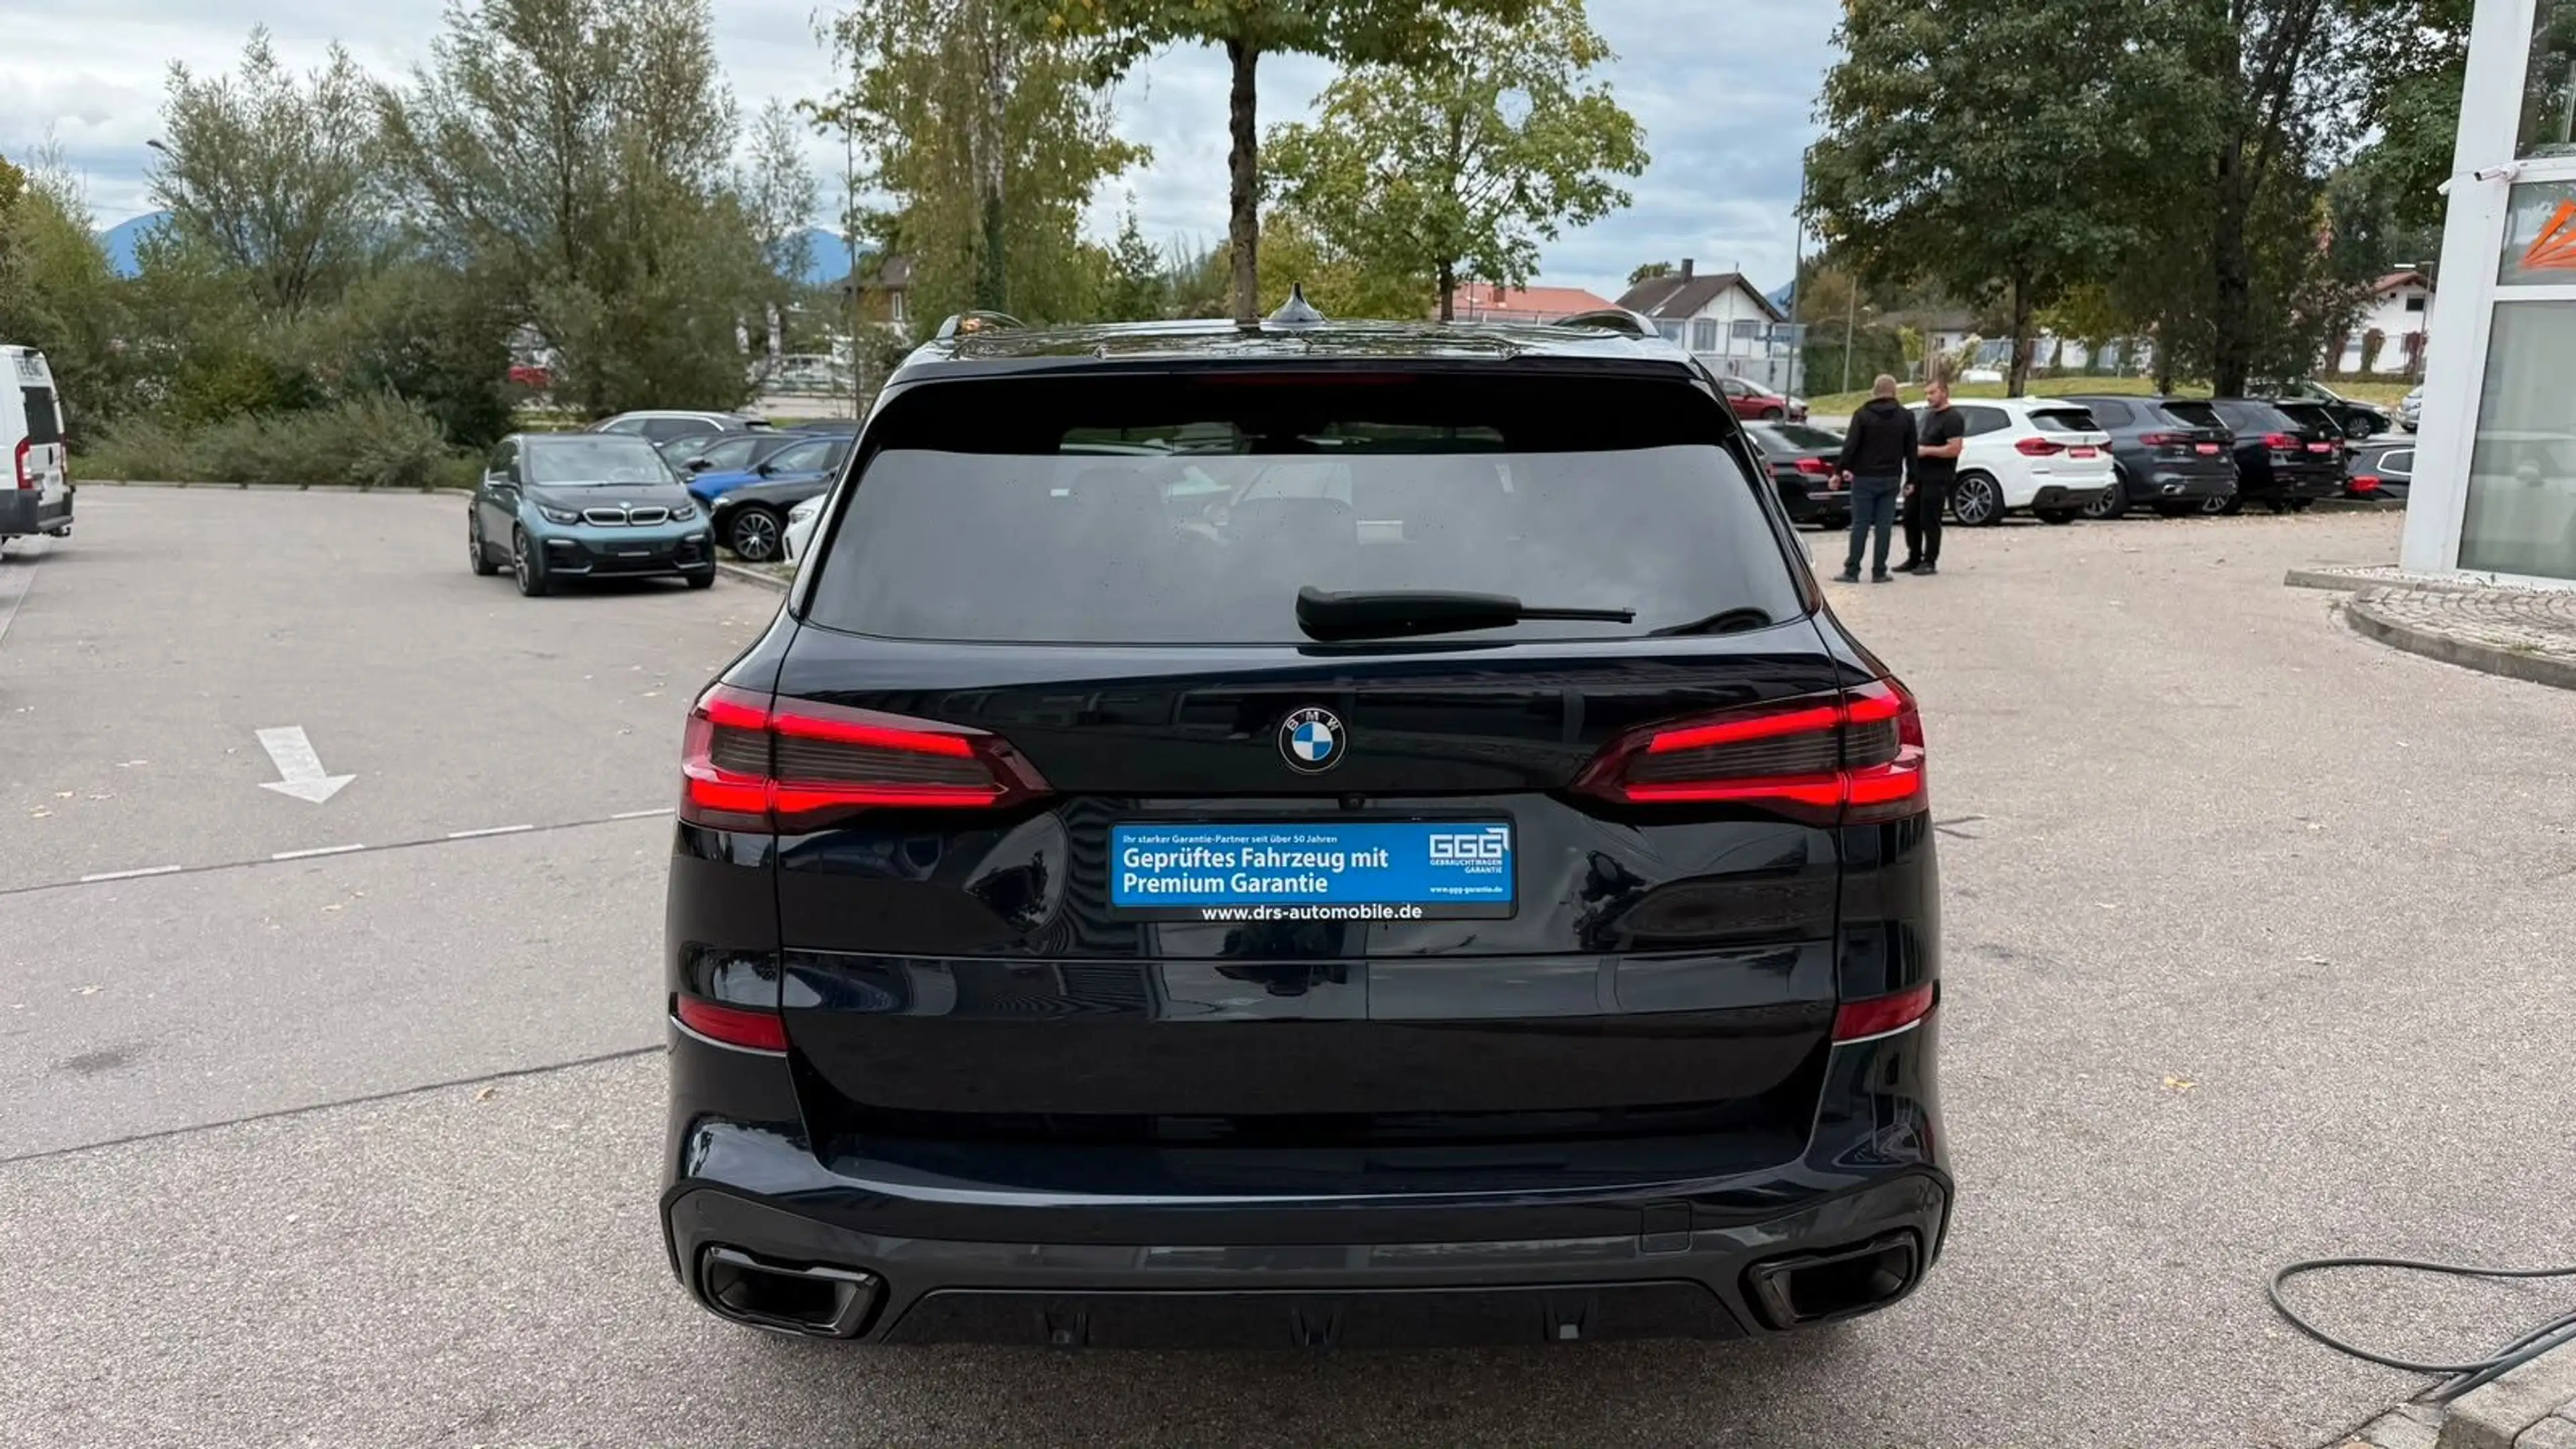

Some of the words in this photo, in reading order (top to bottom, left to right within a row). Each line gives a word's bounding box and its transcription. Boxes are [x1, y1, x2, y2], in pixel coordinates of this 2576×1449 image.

[1287, 711, 1340, 732] BMW
[1123, 835, 1136, 843] Ihr
[1138, 835, 1170, 843] starker
[1172, 835, 1250, 843] Garantie-Partner
[1251, 835, 1268, 843] seit
[1270, 835, 1291, 843] über
[1293, 835, 1305, 843] 50
[1306, 835, 1338, 843] Jahren
[1430, 834, 1502, 858] GGG
[1123, 847, 1236, 873] Geprüftes
[1241, 847, 1345, 873] Fahrzeug
[1351, 847, 1389, 869] mit
[1464, 866, 1503, 874] GARANTIE
[1123, 872, 1225, 894] Premium
[1230, 872, 1328, 894] Garantie
[1201, 904, 1423, 920] www.drs-automobile.de
